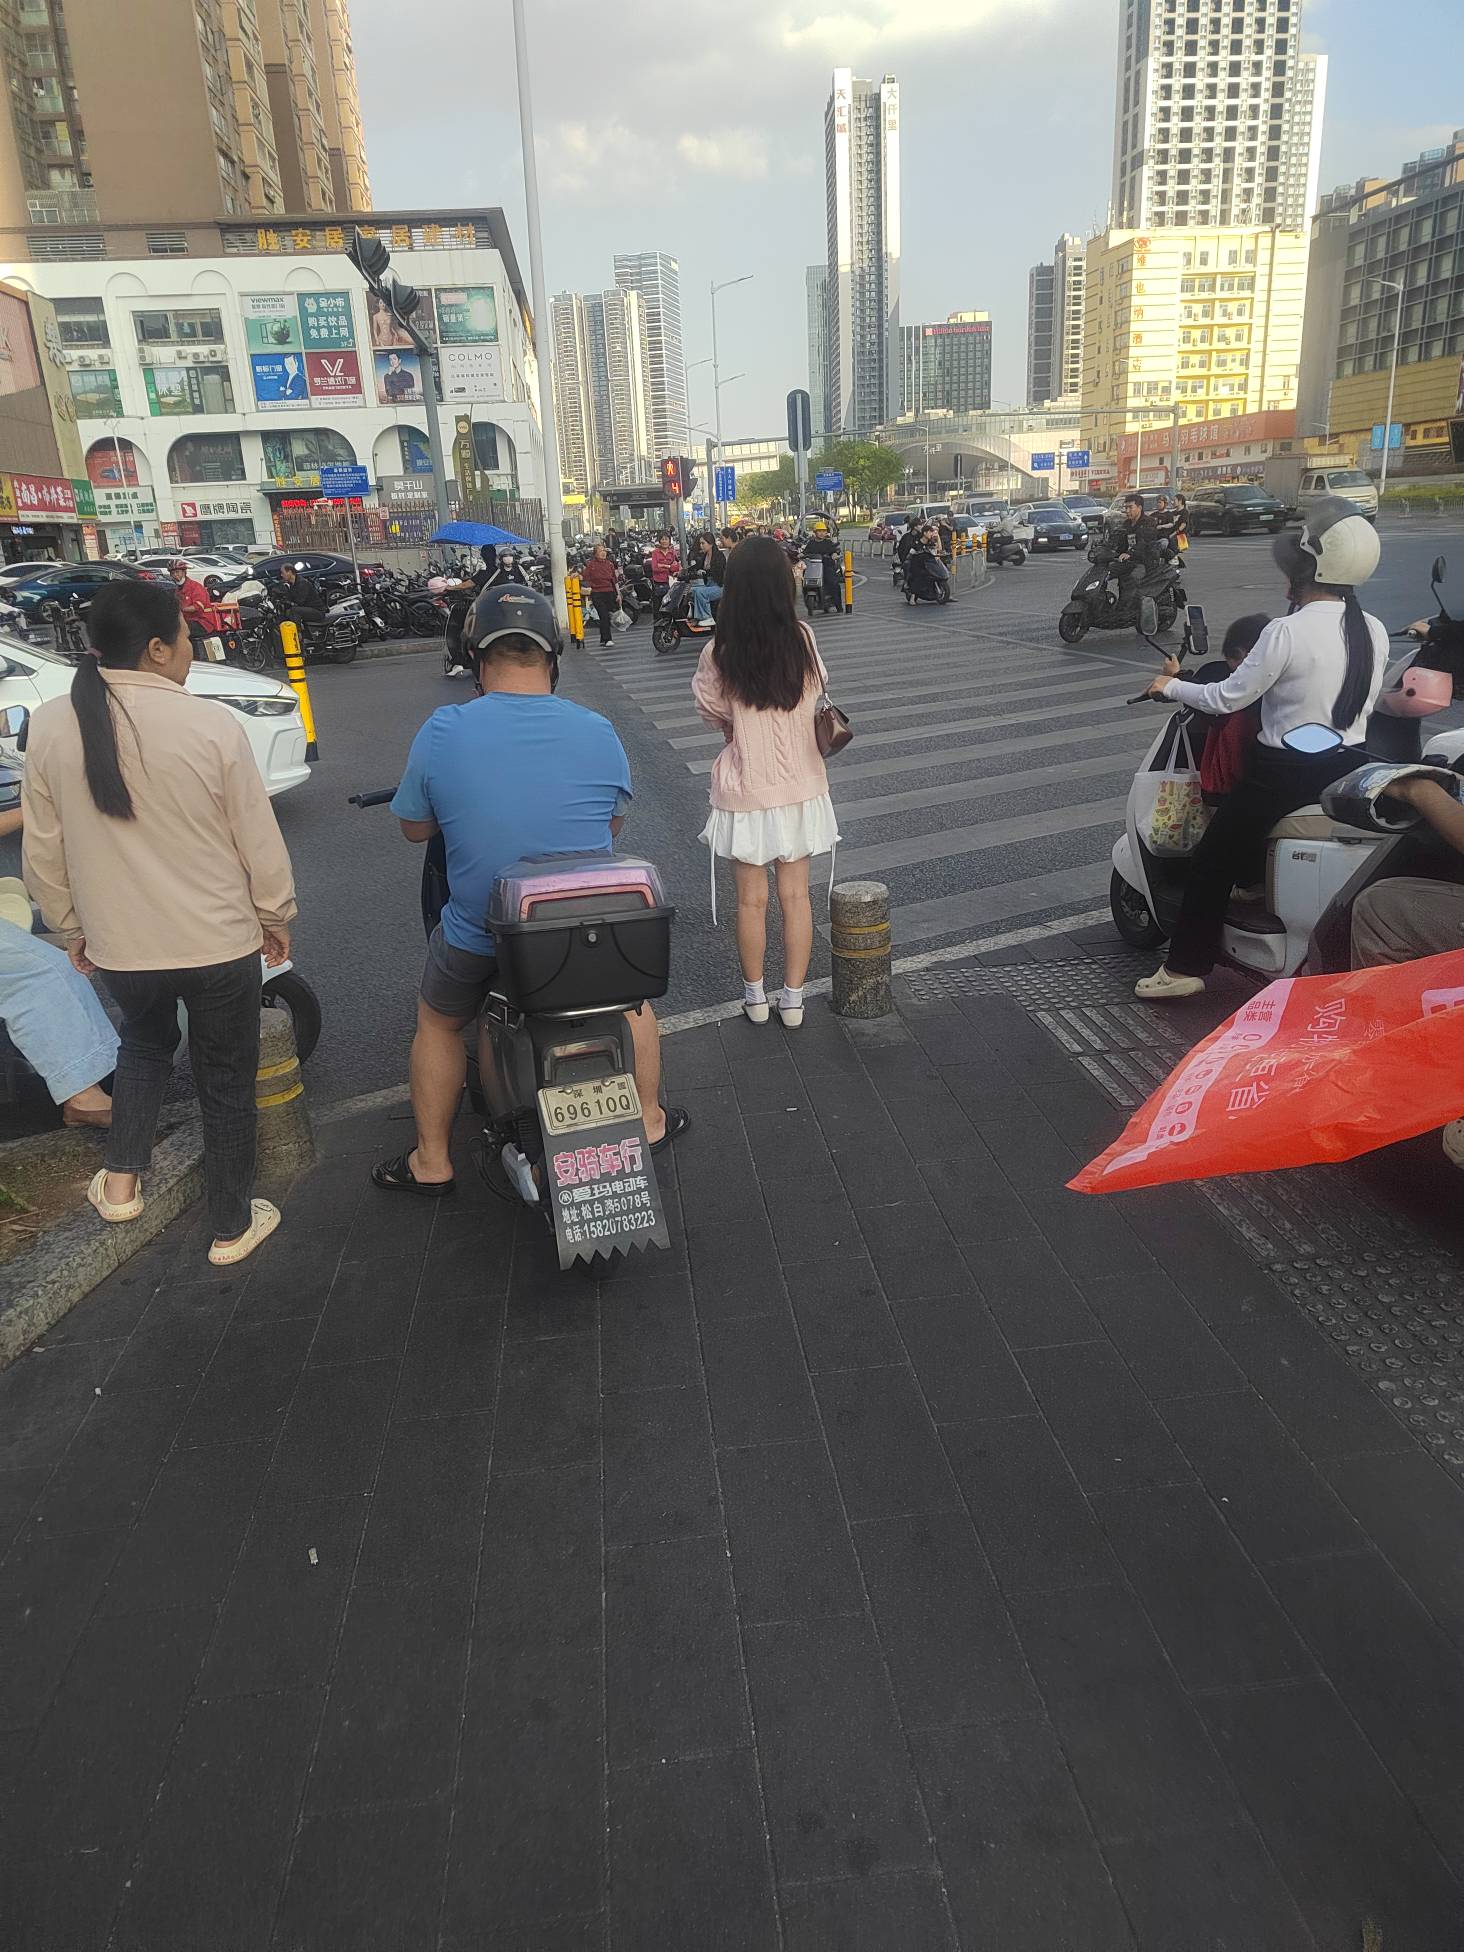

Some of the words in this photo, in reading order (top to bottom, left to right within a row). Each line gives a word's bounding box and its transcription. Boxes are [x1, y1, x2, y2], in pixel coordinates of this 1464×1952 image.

[307, 315, 348, 327] 购买饮品
[309, 327, 349, 339] 免费上网
[448, 352, 493, 362] COLMO
[573, 1086, 603, 1099] 深圳
[553, 1094, 631, 1123] 69610Q
[553, 1137, 643, 1187] 安骑车行
[572, 1175, 649, 1202] 爱玛电动车
